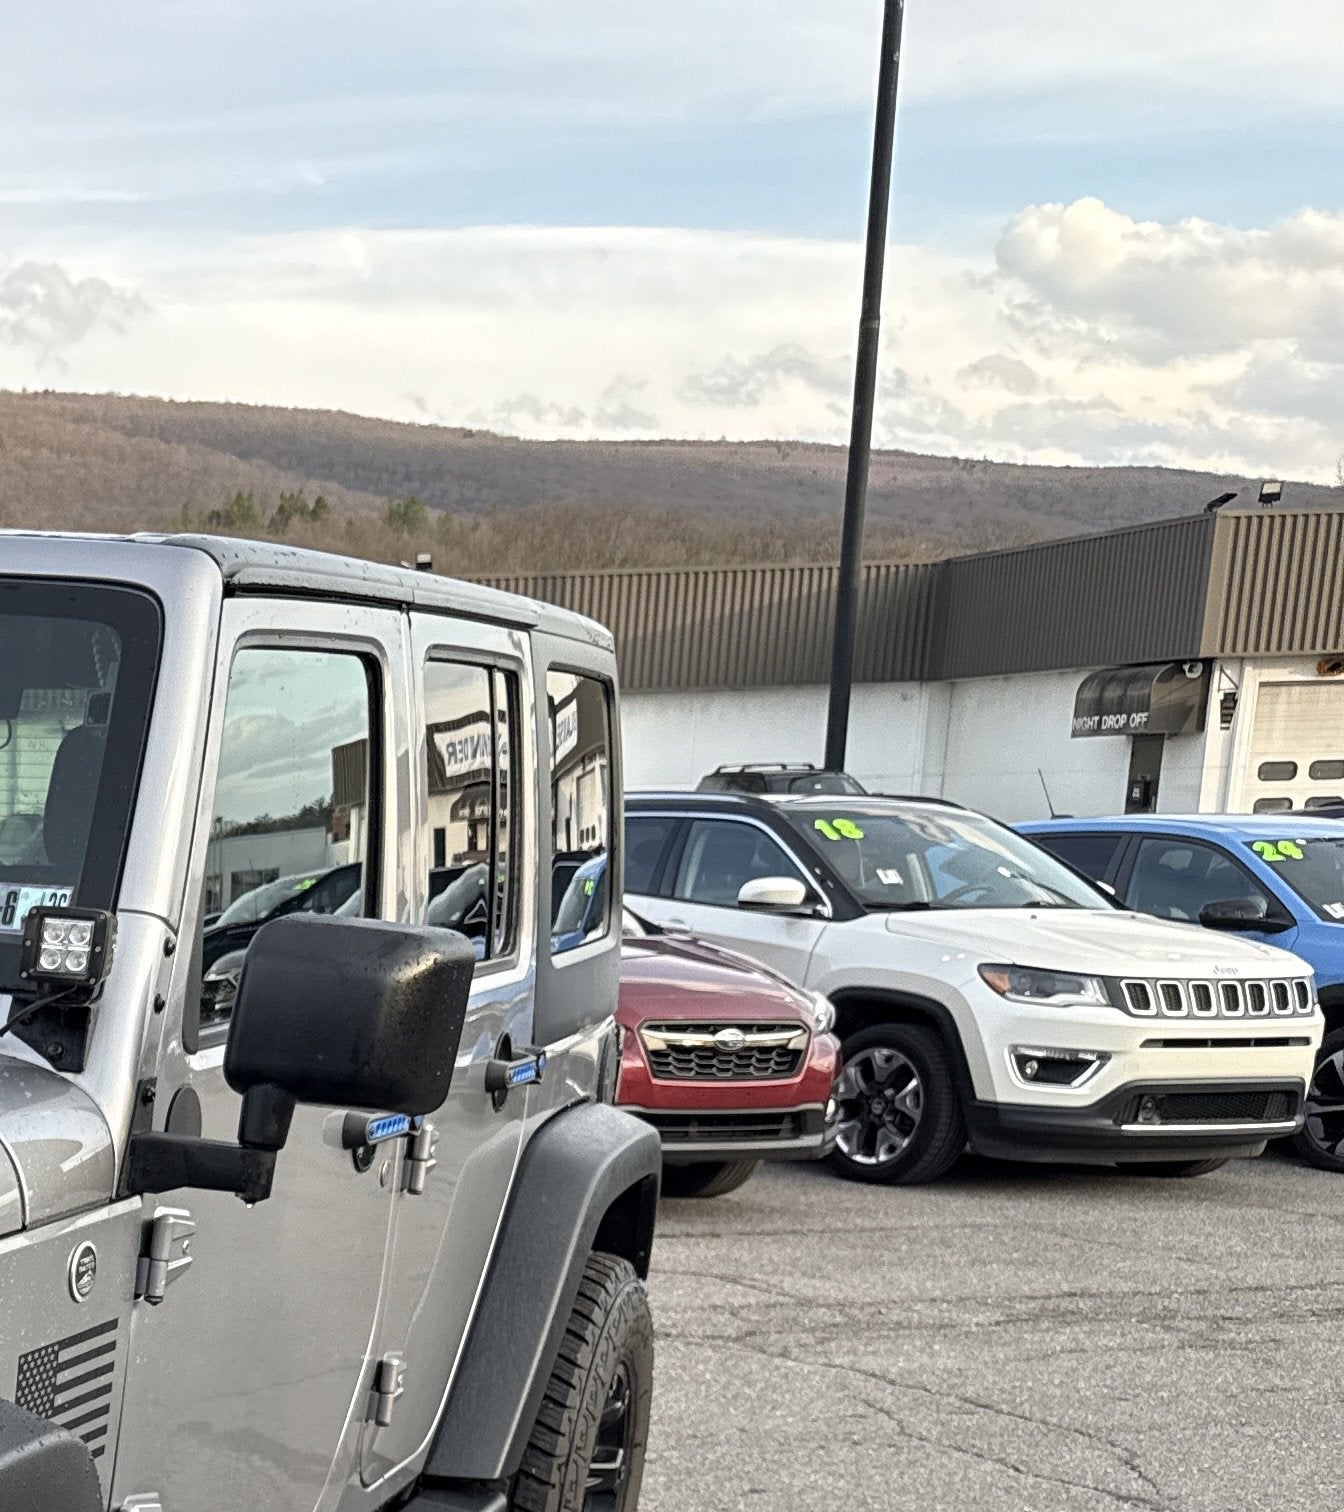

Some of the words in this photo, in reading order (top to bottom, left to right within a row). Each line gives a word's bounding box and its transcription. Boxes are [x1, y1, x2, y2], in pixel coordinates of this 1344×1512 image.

[1072, 715, 1100, 730] NIGHT
[1101, 714, 1127, 730] DROP
[1129, 711, 1149, 728] OFF
[814, 818, 864, 840] 18
